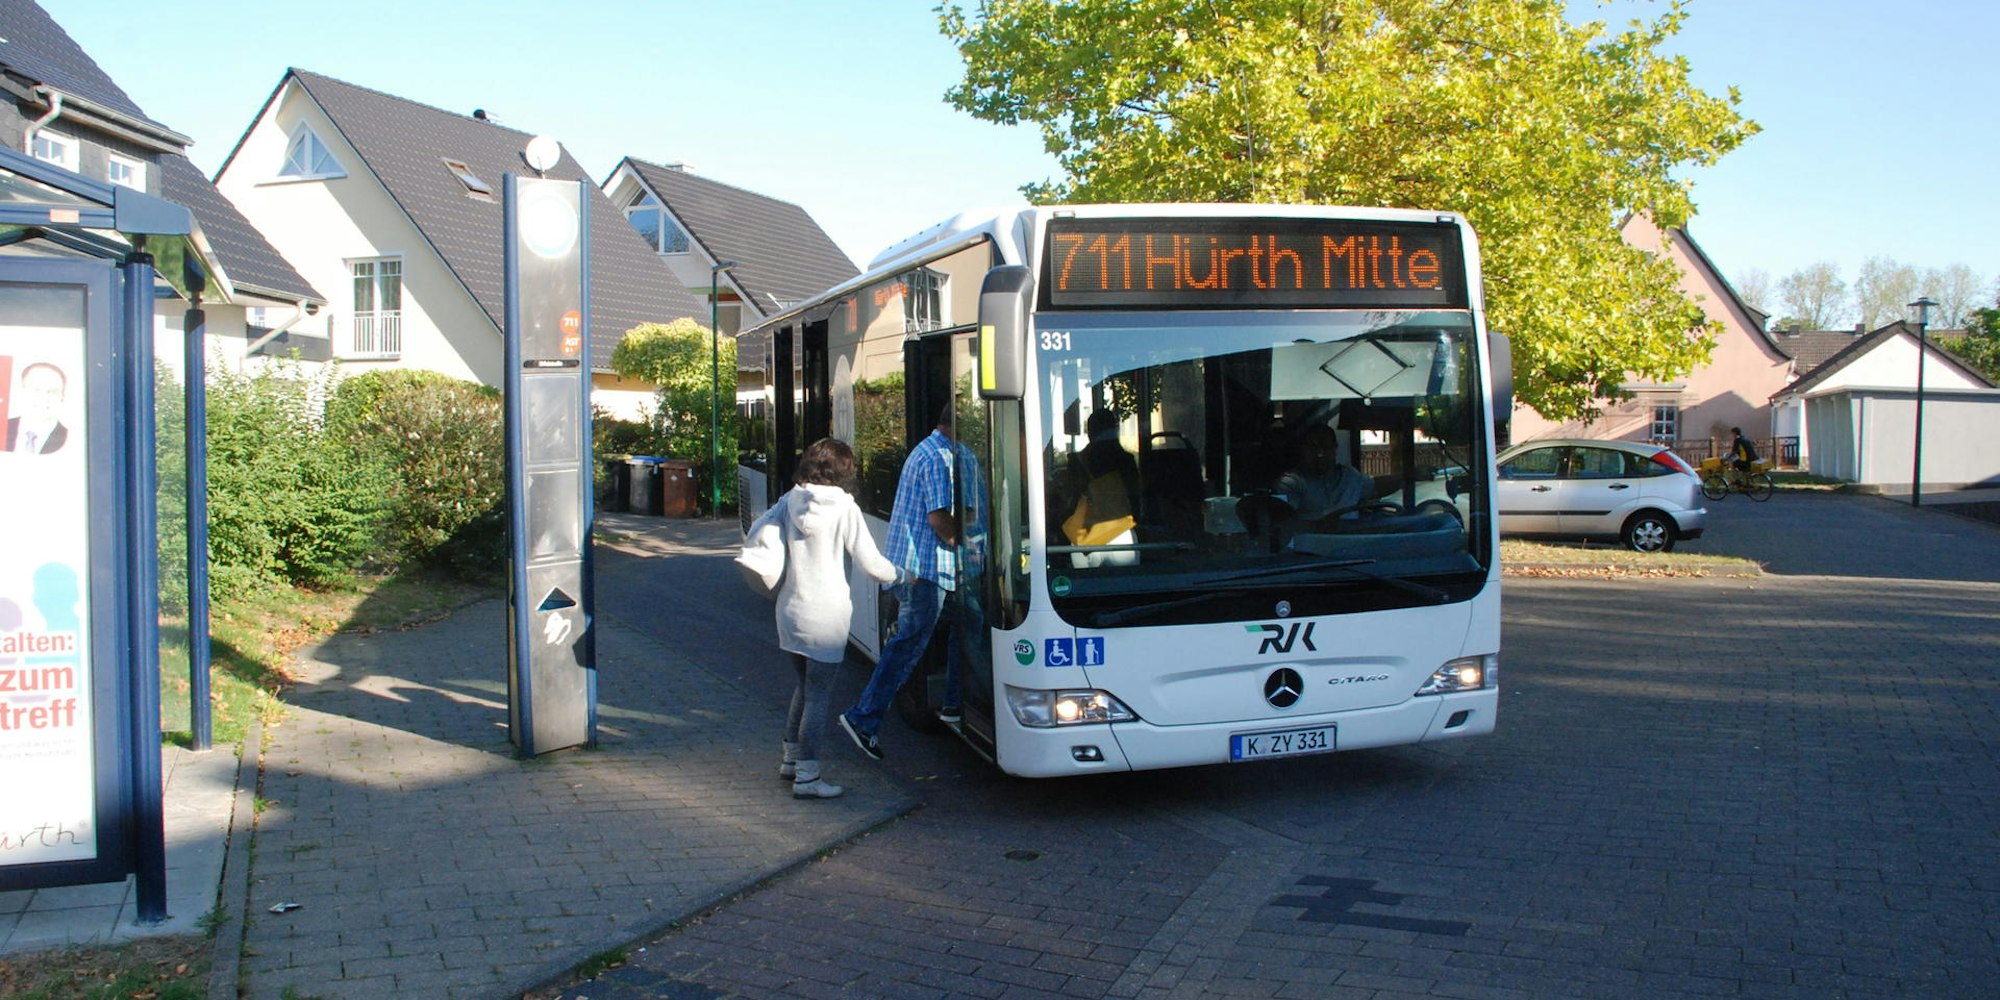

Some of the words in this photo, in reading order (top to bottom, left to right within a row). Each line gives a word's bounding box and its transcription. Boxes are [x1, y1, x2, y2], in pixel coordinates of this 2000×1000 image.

[1056, 234, 1131, 290] 711
[1146, 234, 1303, 289] Hürth
[1322, 235, 1440, 289] Mitte
[563, 317, 578, 327] 711
[1041, 331, 1071, 351] 331
[0, 632, 73, 653] alten:
[1013, 643, 1030, 654] VRS
[0, 667, 73, 691] zum
[1328, 673, 1389, 685] CITARO
[0, 698, 76, 730] treff
[1248, 738, 1259, 756] K
[1271, 734, 1292, 753] ZY
[1297, 731, 1327, 749] 331
